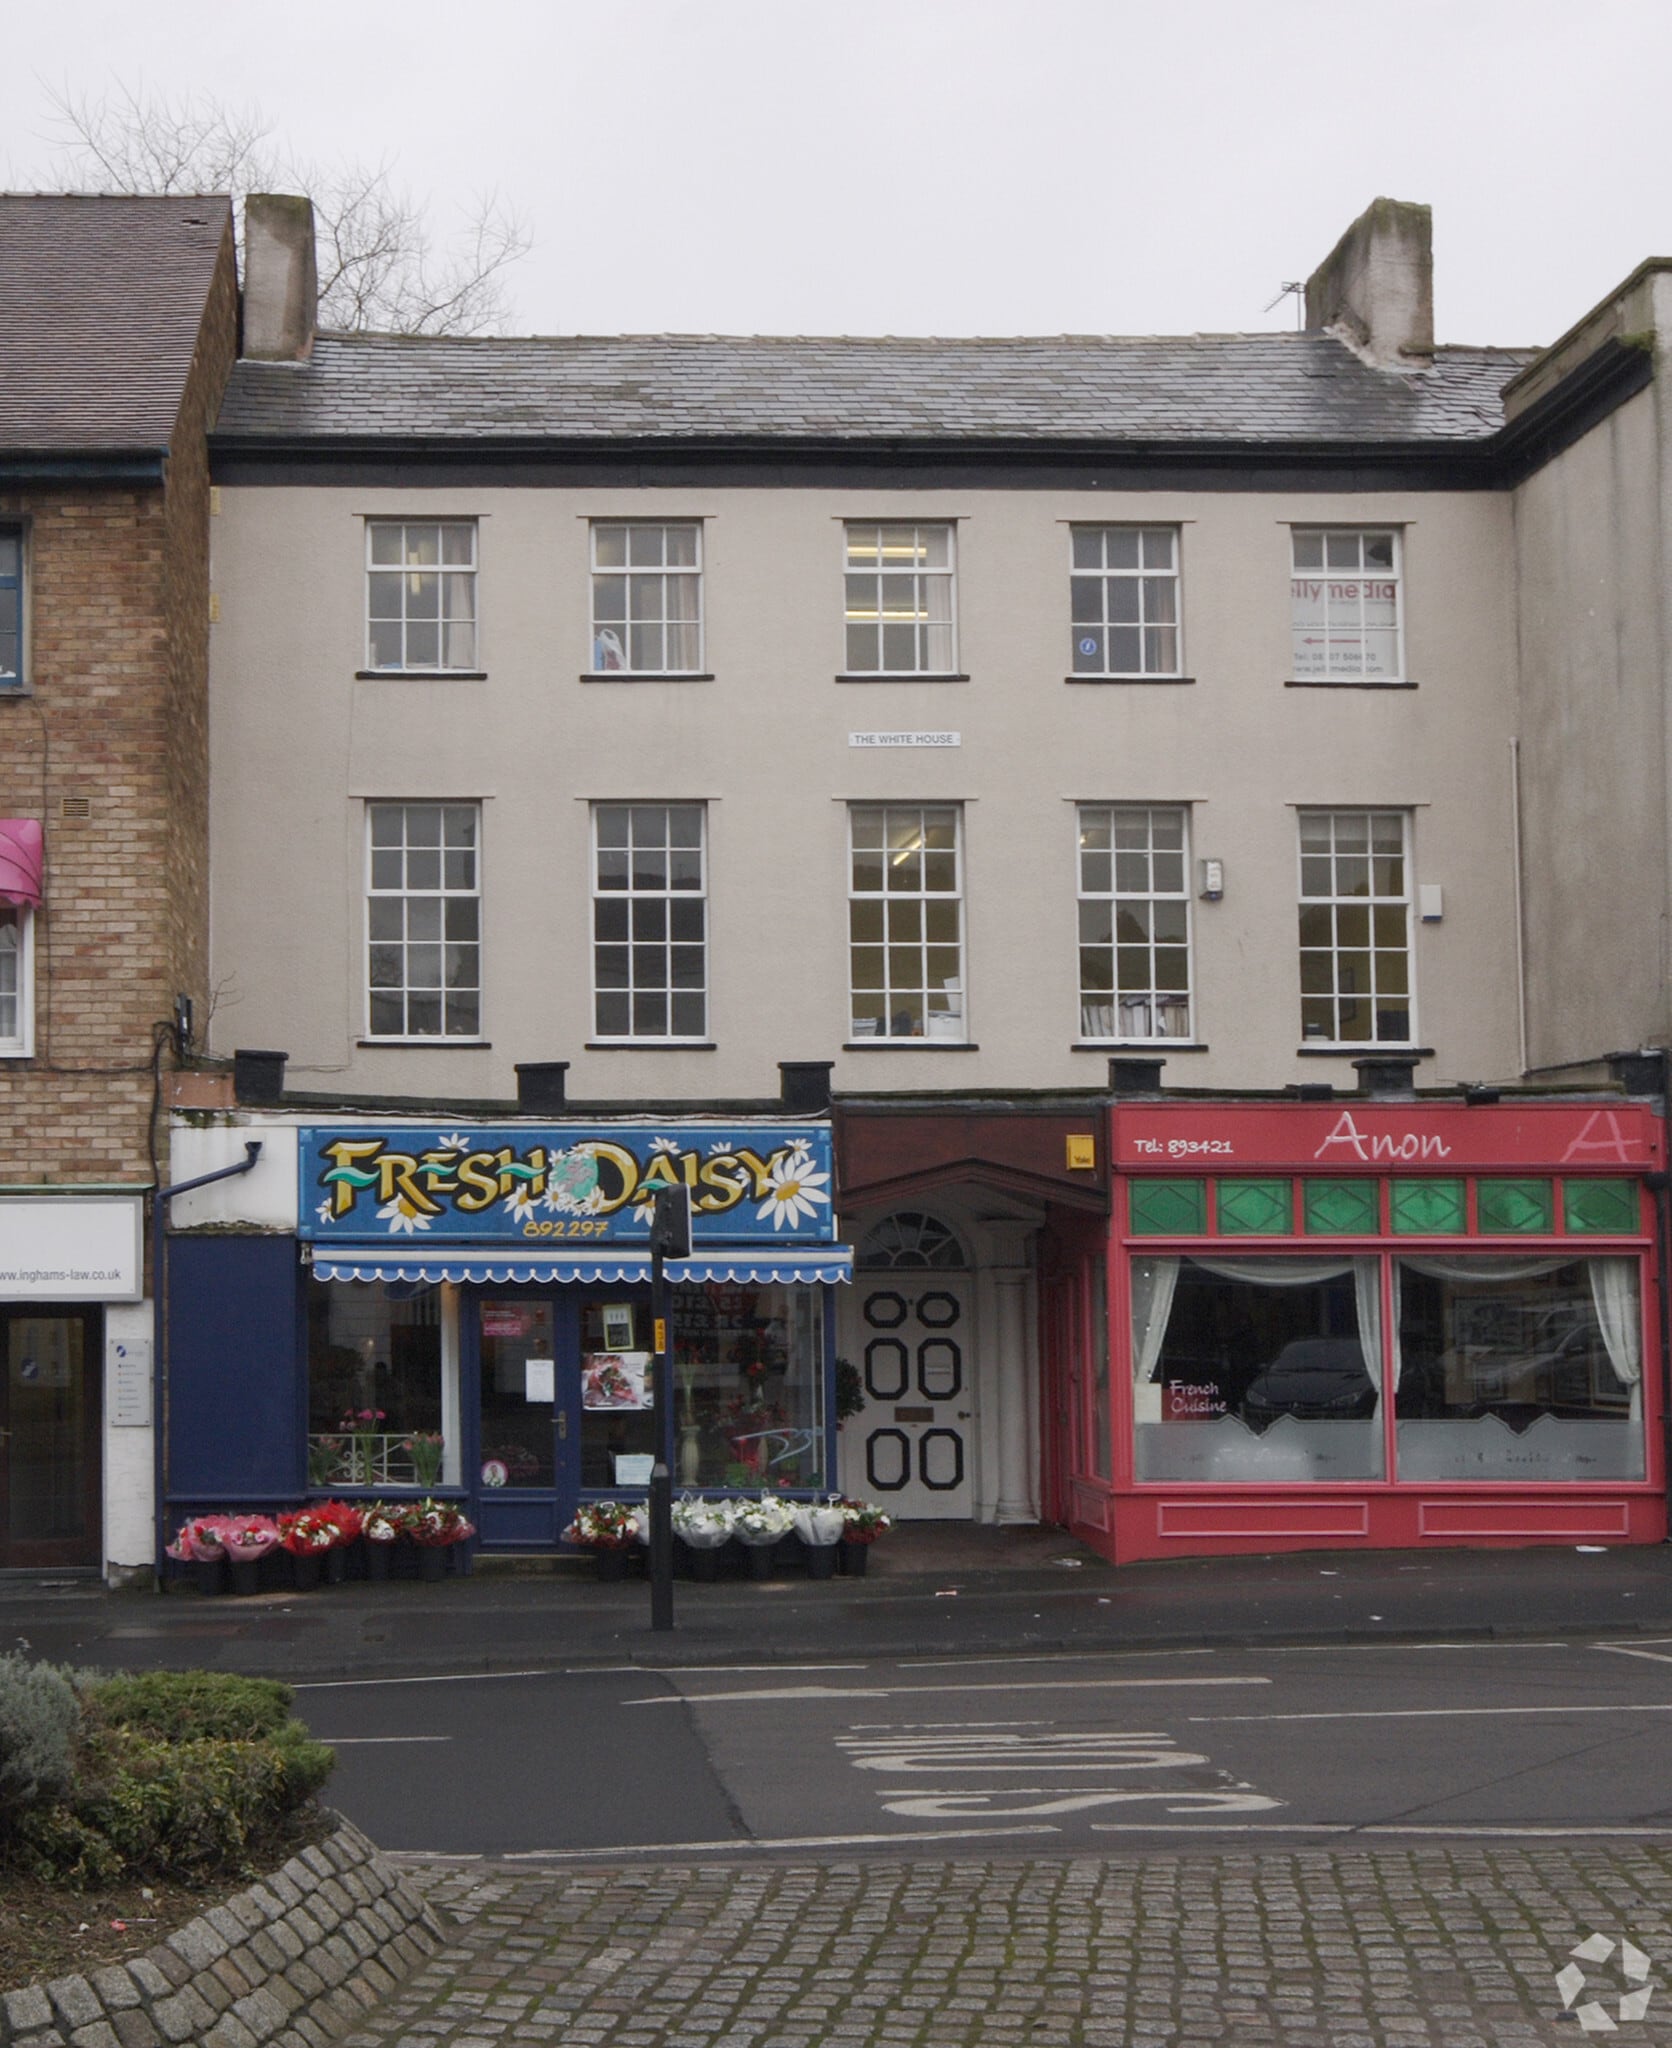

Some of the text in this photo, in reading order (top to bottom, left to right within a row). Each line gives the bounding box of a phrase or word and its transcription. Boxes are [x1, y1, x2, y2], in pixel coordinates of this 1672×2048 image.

[855, 735, 953, 744] THE WHITE HOUSE
[1314, 1110, 1452, 1161] Anon
[1560, 1110, 1642, 1163] A
[1133, 1138, 1234, 1158] Tel: 893421
[323, 1140, 789, 1214] FRESH DAISY
[522, 1221, 608, 1238] 892297
[1170, 1379, 1219, 1395] French
[1171, 1397, 1227, 1413] Cuisine
